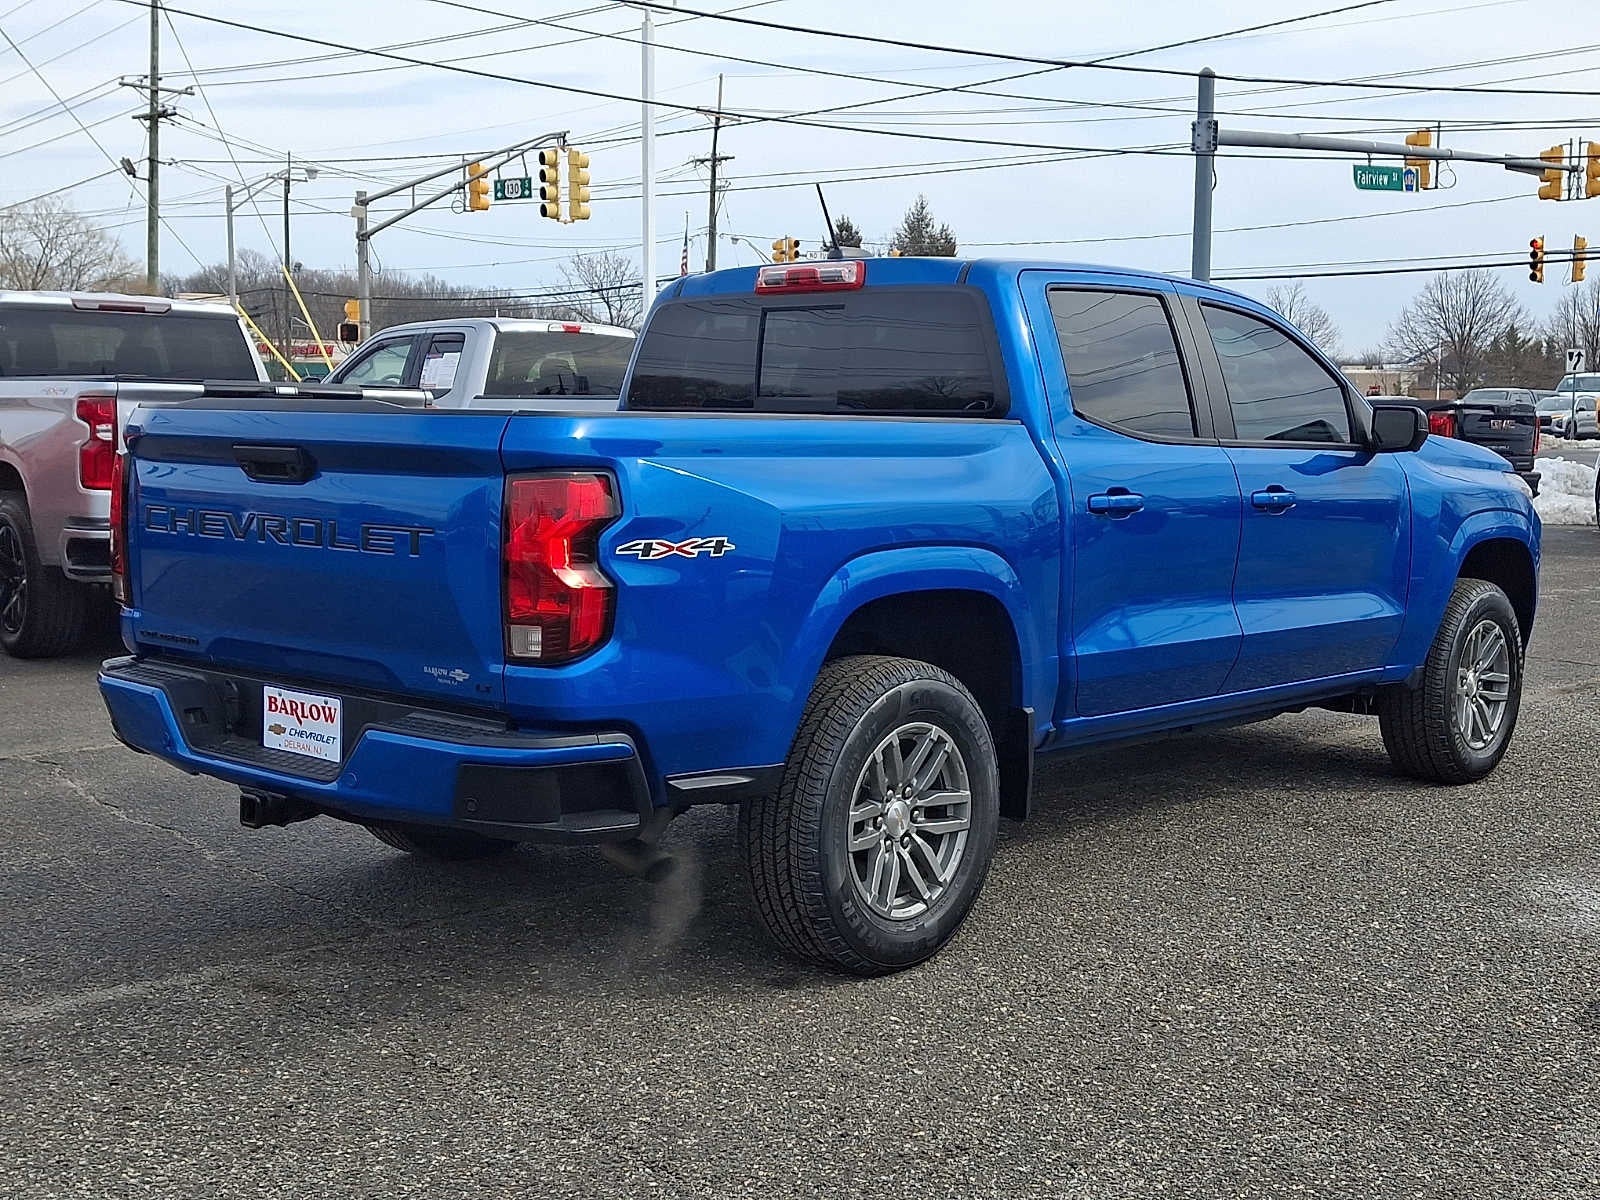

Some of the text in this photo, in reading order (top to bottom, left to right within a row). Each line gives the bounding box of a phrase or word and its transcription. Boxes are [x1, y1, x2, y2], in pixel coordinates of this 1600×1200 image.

[1357, 170, 1389, 186] Fairview
[507, 183, 519, 195] 130
[144, 504, 435, 558] CHEVROLET
[267, 695, 337, 727] BARLOW
[288, 727, 337, 745] CHEVROLET
[313, 746, 322, 755] NJ
